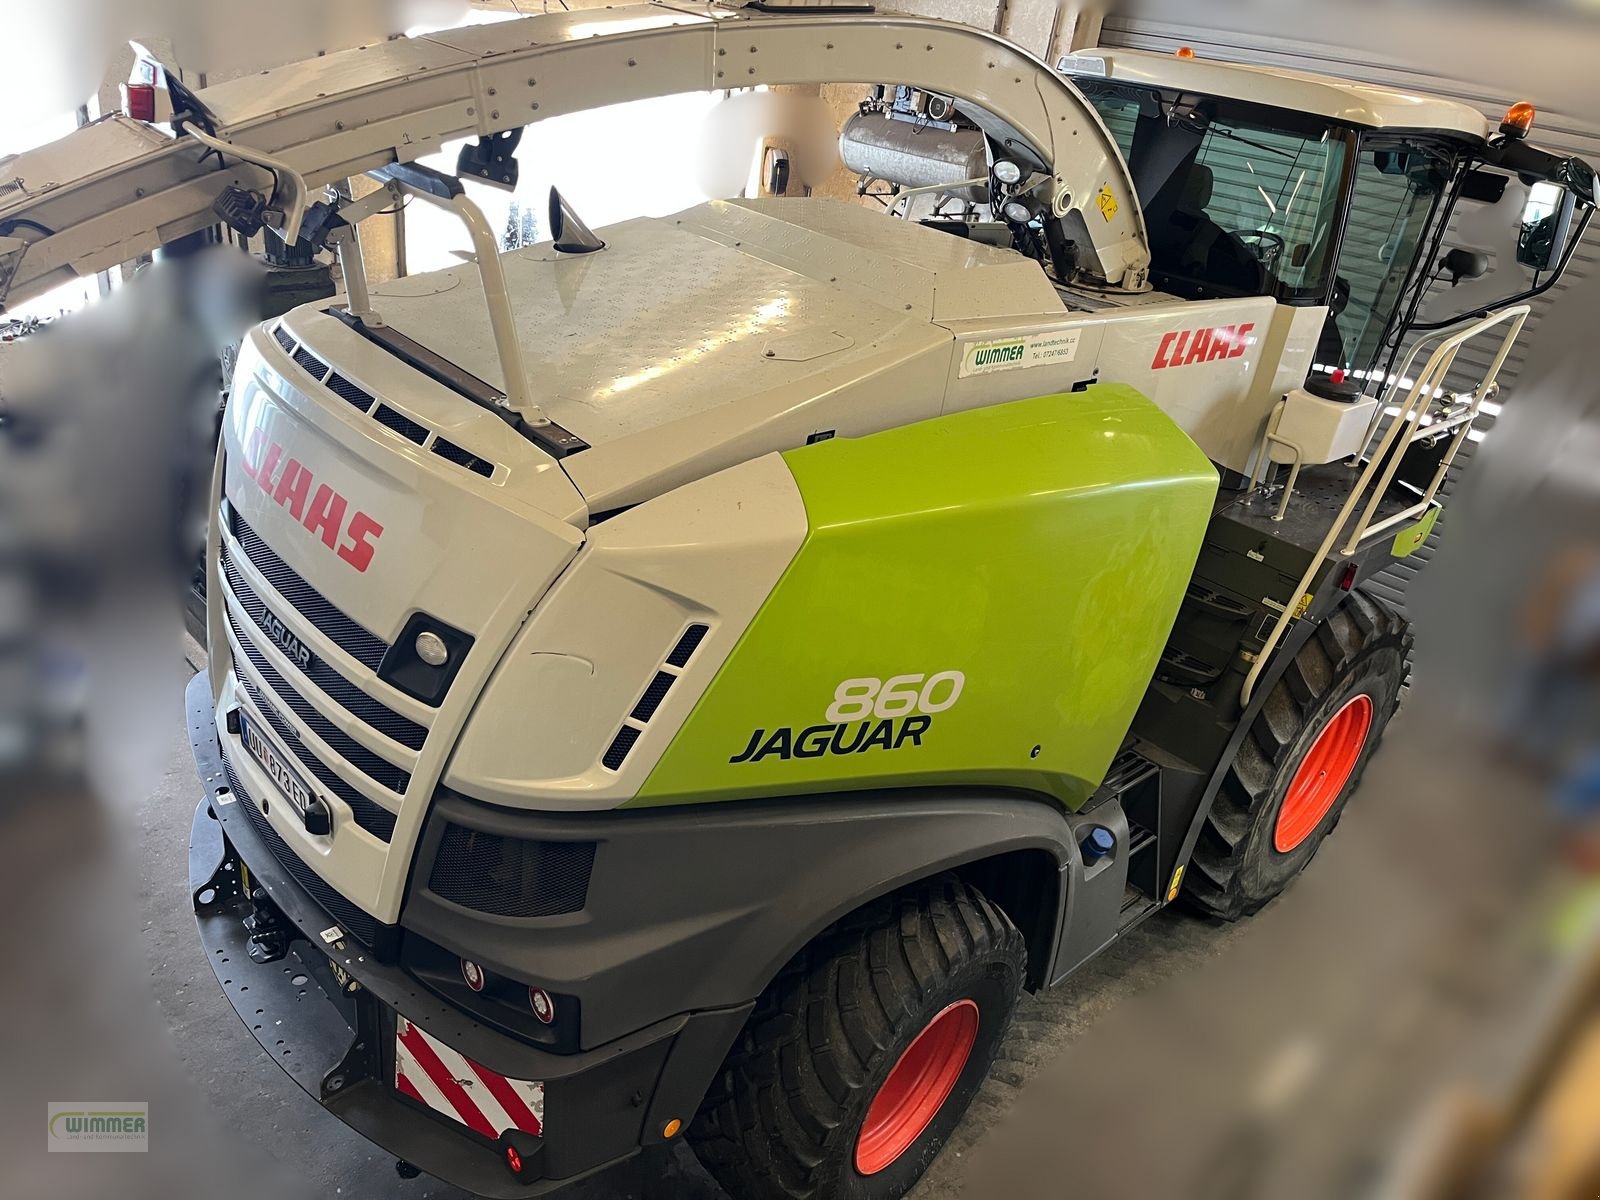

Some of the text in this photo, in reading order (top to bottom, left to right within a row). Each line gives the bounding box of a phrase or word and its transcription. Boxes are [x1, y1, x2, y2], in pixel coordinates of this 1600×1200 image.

[975, 345, 1024, 366] WIMMER
[1151, 323, 1255, 369] CLAAS
[241, 427, 384, 573] CLAAS
[825, 671, 965, 722] 860
[729, 715, 931, 763] JAGUAR
